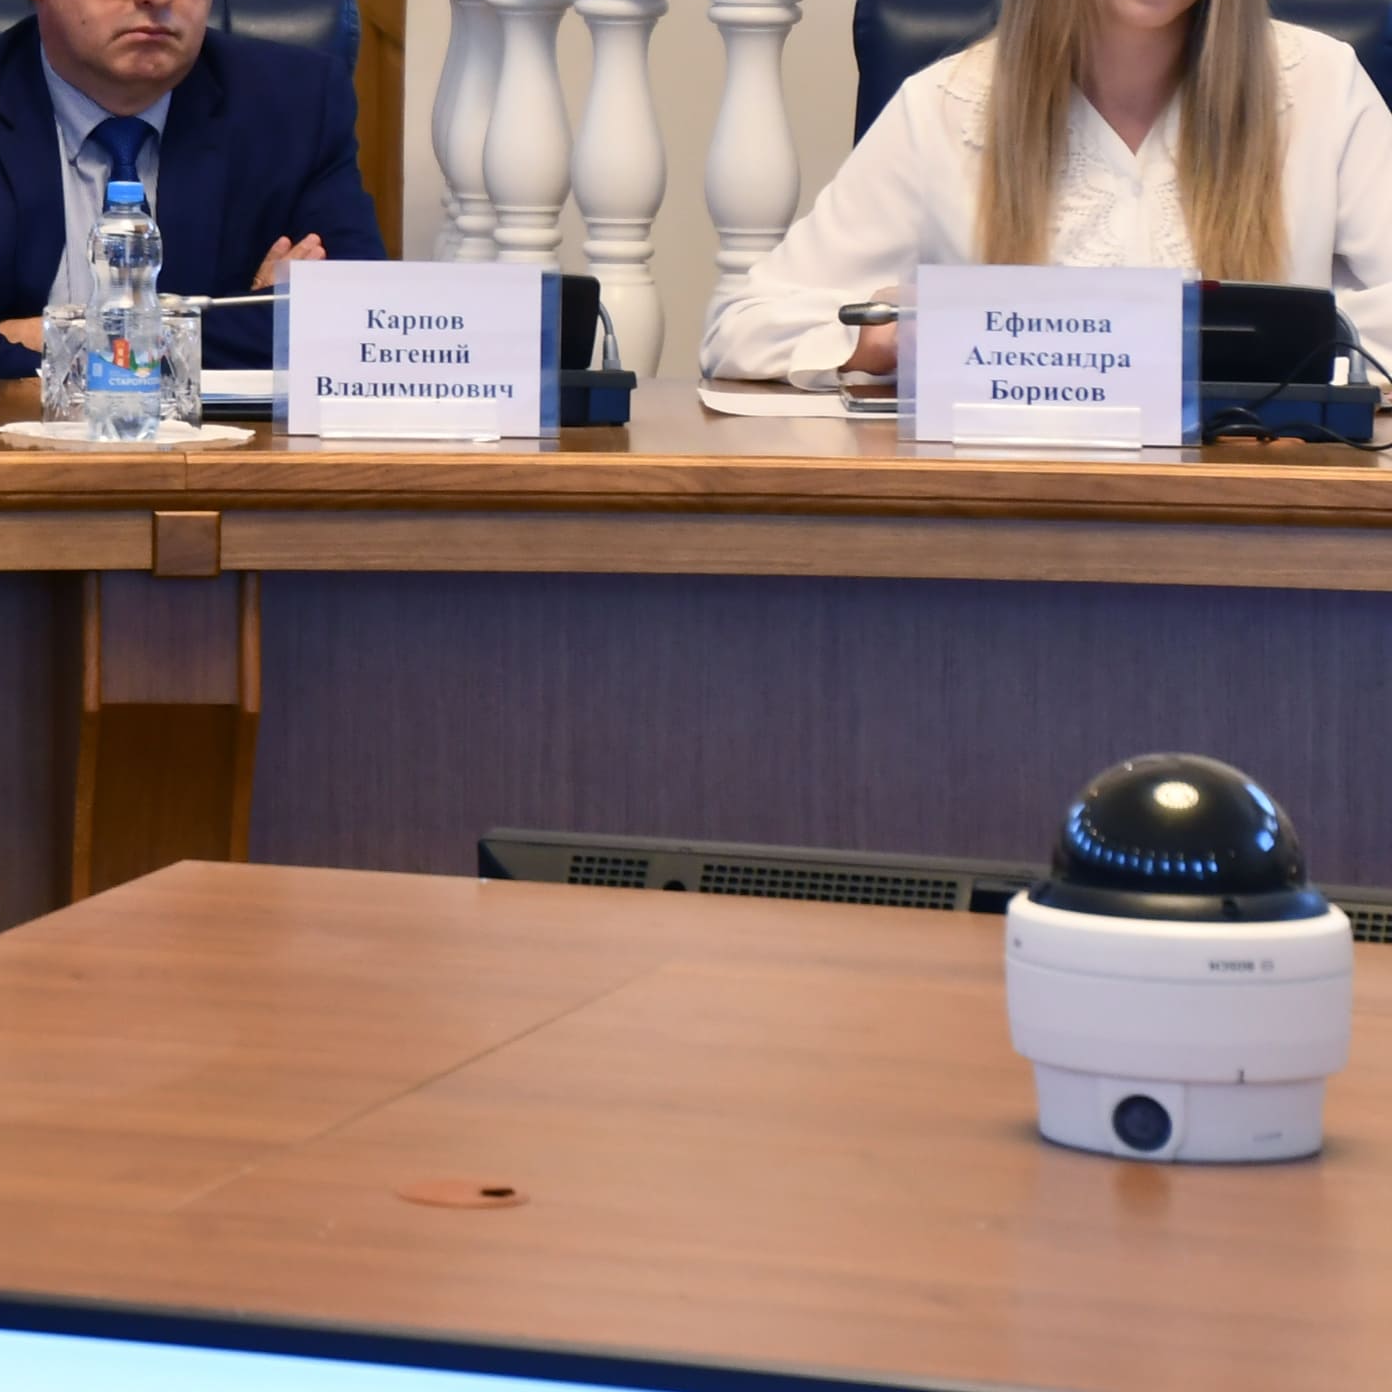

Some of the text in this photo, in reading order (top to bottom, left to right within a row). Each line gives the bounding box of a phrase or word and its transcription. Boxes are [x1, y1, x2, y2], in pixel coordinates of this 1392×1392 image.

[367, 308, 465, 336] Карпов
[985, 310, 1112, 339] Ефимова
[359, 342, 471, 365] Евгений
[964, 345, 1132, 375] Александра
[316, 375, 513, 400] Владимирович
[990, 379, 1106, 406] Борисов
